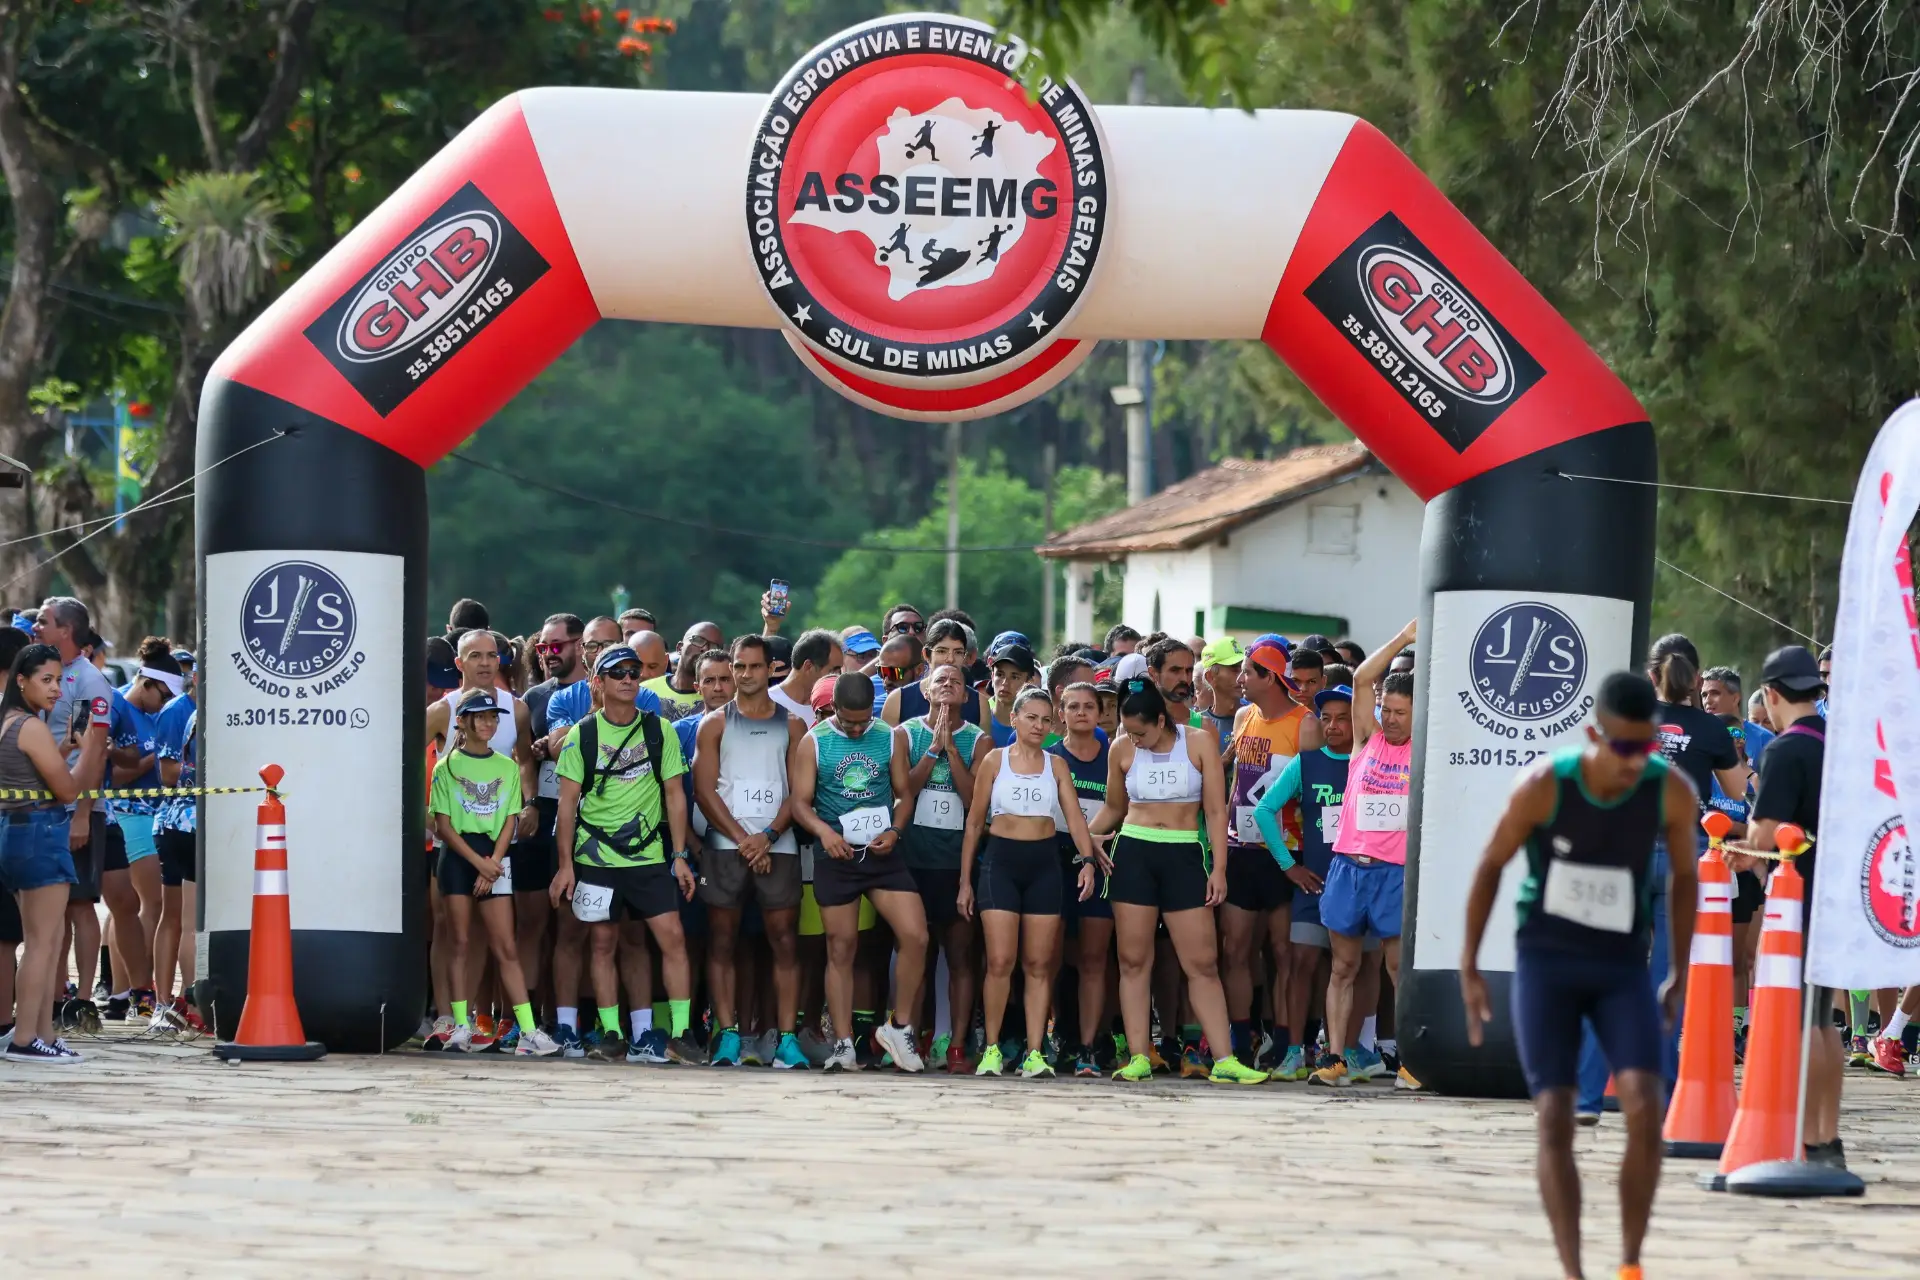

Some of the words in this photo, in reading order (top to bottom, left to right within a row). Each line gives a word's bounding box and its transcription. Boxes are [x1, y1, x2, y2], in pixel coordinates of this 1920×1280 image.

[906, 27, 921, 48] E
[782, 29, 900, 115] ESPORTIVA
[1037, 75, 1065, 108] DE
[1056, 103, 1098, 187] MINAS
[754, 117, 793, 291] ASSOCIAÇÃO
[794, 171, 1058, 220] ASSEEMG
[1056, 196, 1098, 293] GERAIS
[352, 226, 490, 352] GHB
[375, 244, 427, 292] GRUPO
[405, 277, 514, 380] 35.3851.2165
[1367, 260, 1499, 394] GHB
[1430, 282, 1481, 332] GRUPO
[825, 326, 875, 364] SUL
[883, 349, 919, 370] DE
[927, 334, 1013, 370] MINAS
[1342, 314, 1447, 418] 35.3851.2165
[255, 575, 279, 618] J
[316, 593, 344, 629] S
[249, 637, 343, 674] PARAFUSOS
[1486, 616, 1512, 658] J
[1549, 636, 1575, 672] S
[231, 651, 290, 699] ATACADO
[295, 686, 308, 699] &
[311, 651, 366, 696] VAREJO
[1478, 676, 1574, 715] PARAFUSOS
[226, 708, 346, 727] 35.3015.2700
[1458, 690, 1519, 739] ATACADO
[1524, 728, 1536, 740] &
[1540, 695, 1595, 739] VAREJO
[1237, 749, 1267, 767] UNNER
[1240, 735, 1272, 753] FRIEND
[1449, 749, 1547, 767] 35.3015.2
[743, 789, 774, 804] 148
[1011, 786, 1042, 802] 316
[1148, 770, 1177, 785] 315
[850, 814, 883, 831] 278
[933, 800, 950, 815] 19
[1365, 802, 1401, 817] 320
[574, 889, 603, 909] 264
[1899, 844, 1915, 933] ASSEEM
